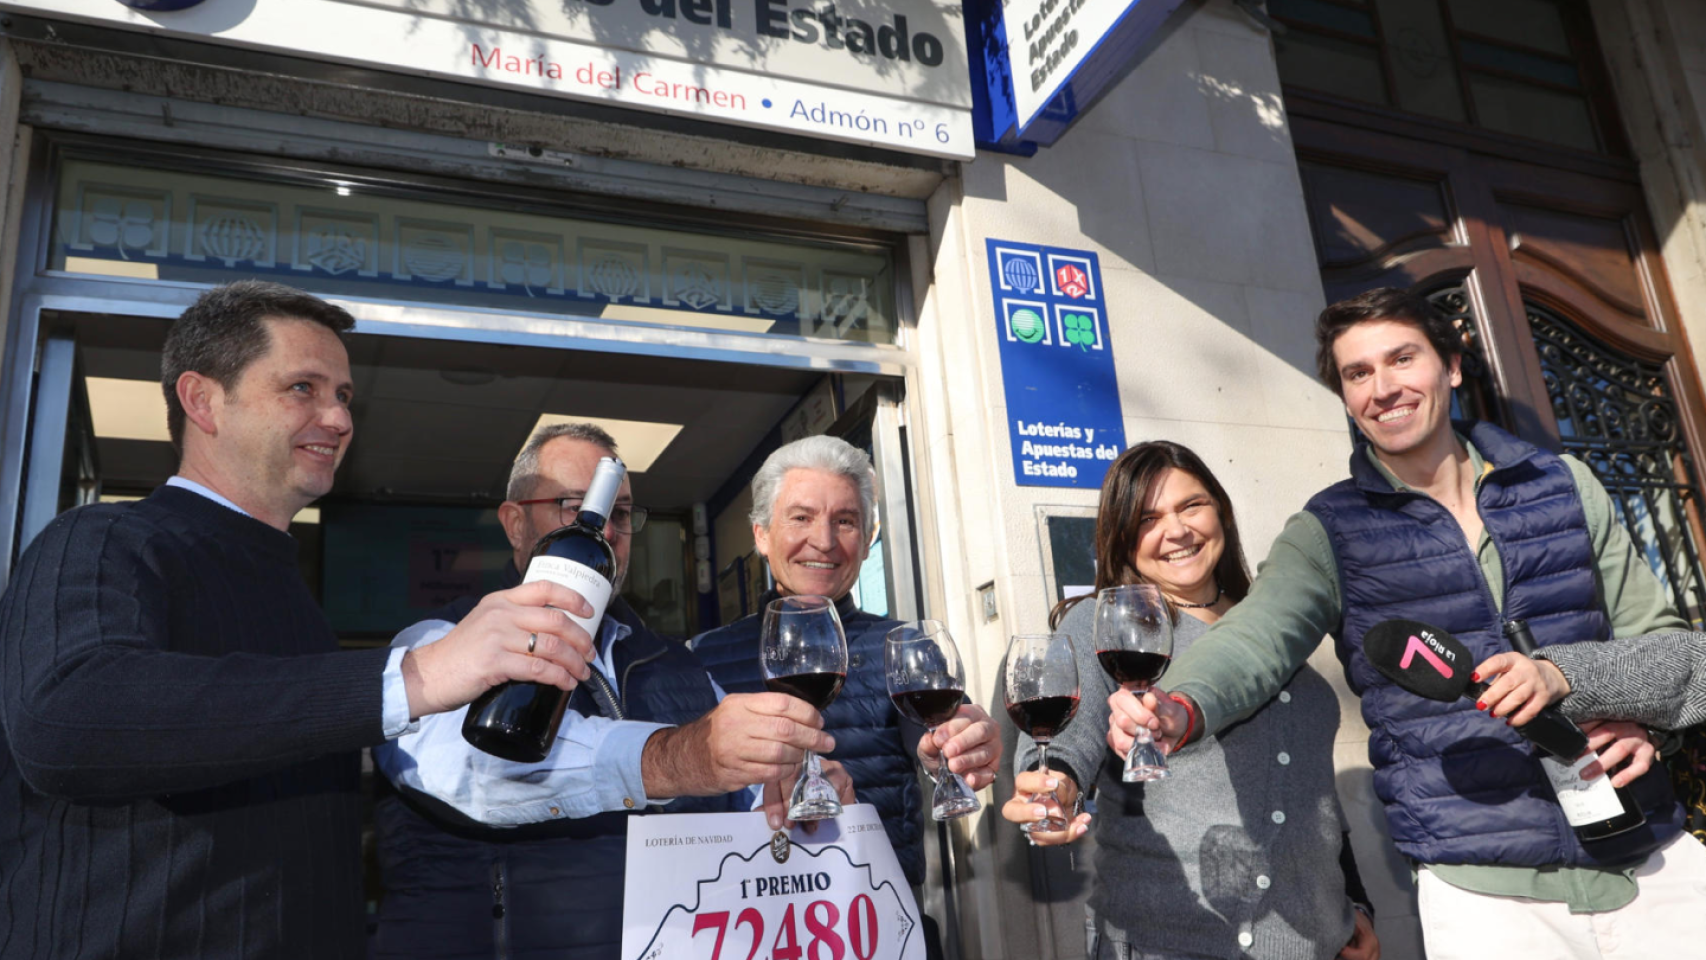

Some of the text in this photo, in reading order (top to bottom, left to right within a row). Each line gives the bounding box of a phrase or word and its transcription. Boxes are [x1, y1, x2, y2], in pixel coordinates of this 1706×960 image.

[756, 0, 944, 67] Estado
[1031, 28, 1079, 93] Estado
[471, 43, 562, 80] María
[576, 62, 621, 90] del
[633, 72, 746, 111] Carmen
[789, 99, 887, 135] Admón
[935, 123, 950, 144] 6
[1017, 420, 1094, 444] Loterías y
[1021, 440, 1119, 460] Apuestas del
[1022, 460, 1078, 478] Estado
[1420, 630, 1446, 655] Rioja
[1400, 635, 1454, 679] 7
[645, 834, 733, 847] LOTERÍA DE NAVIDAD
[755, 871, 832, 897] PREMIO
[692, 893, 878, 960] 72480
